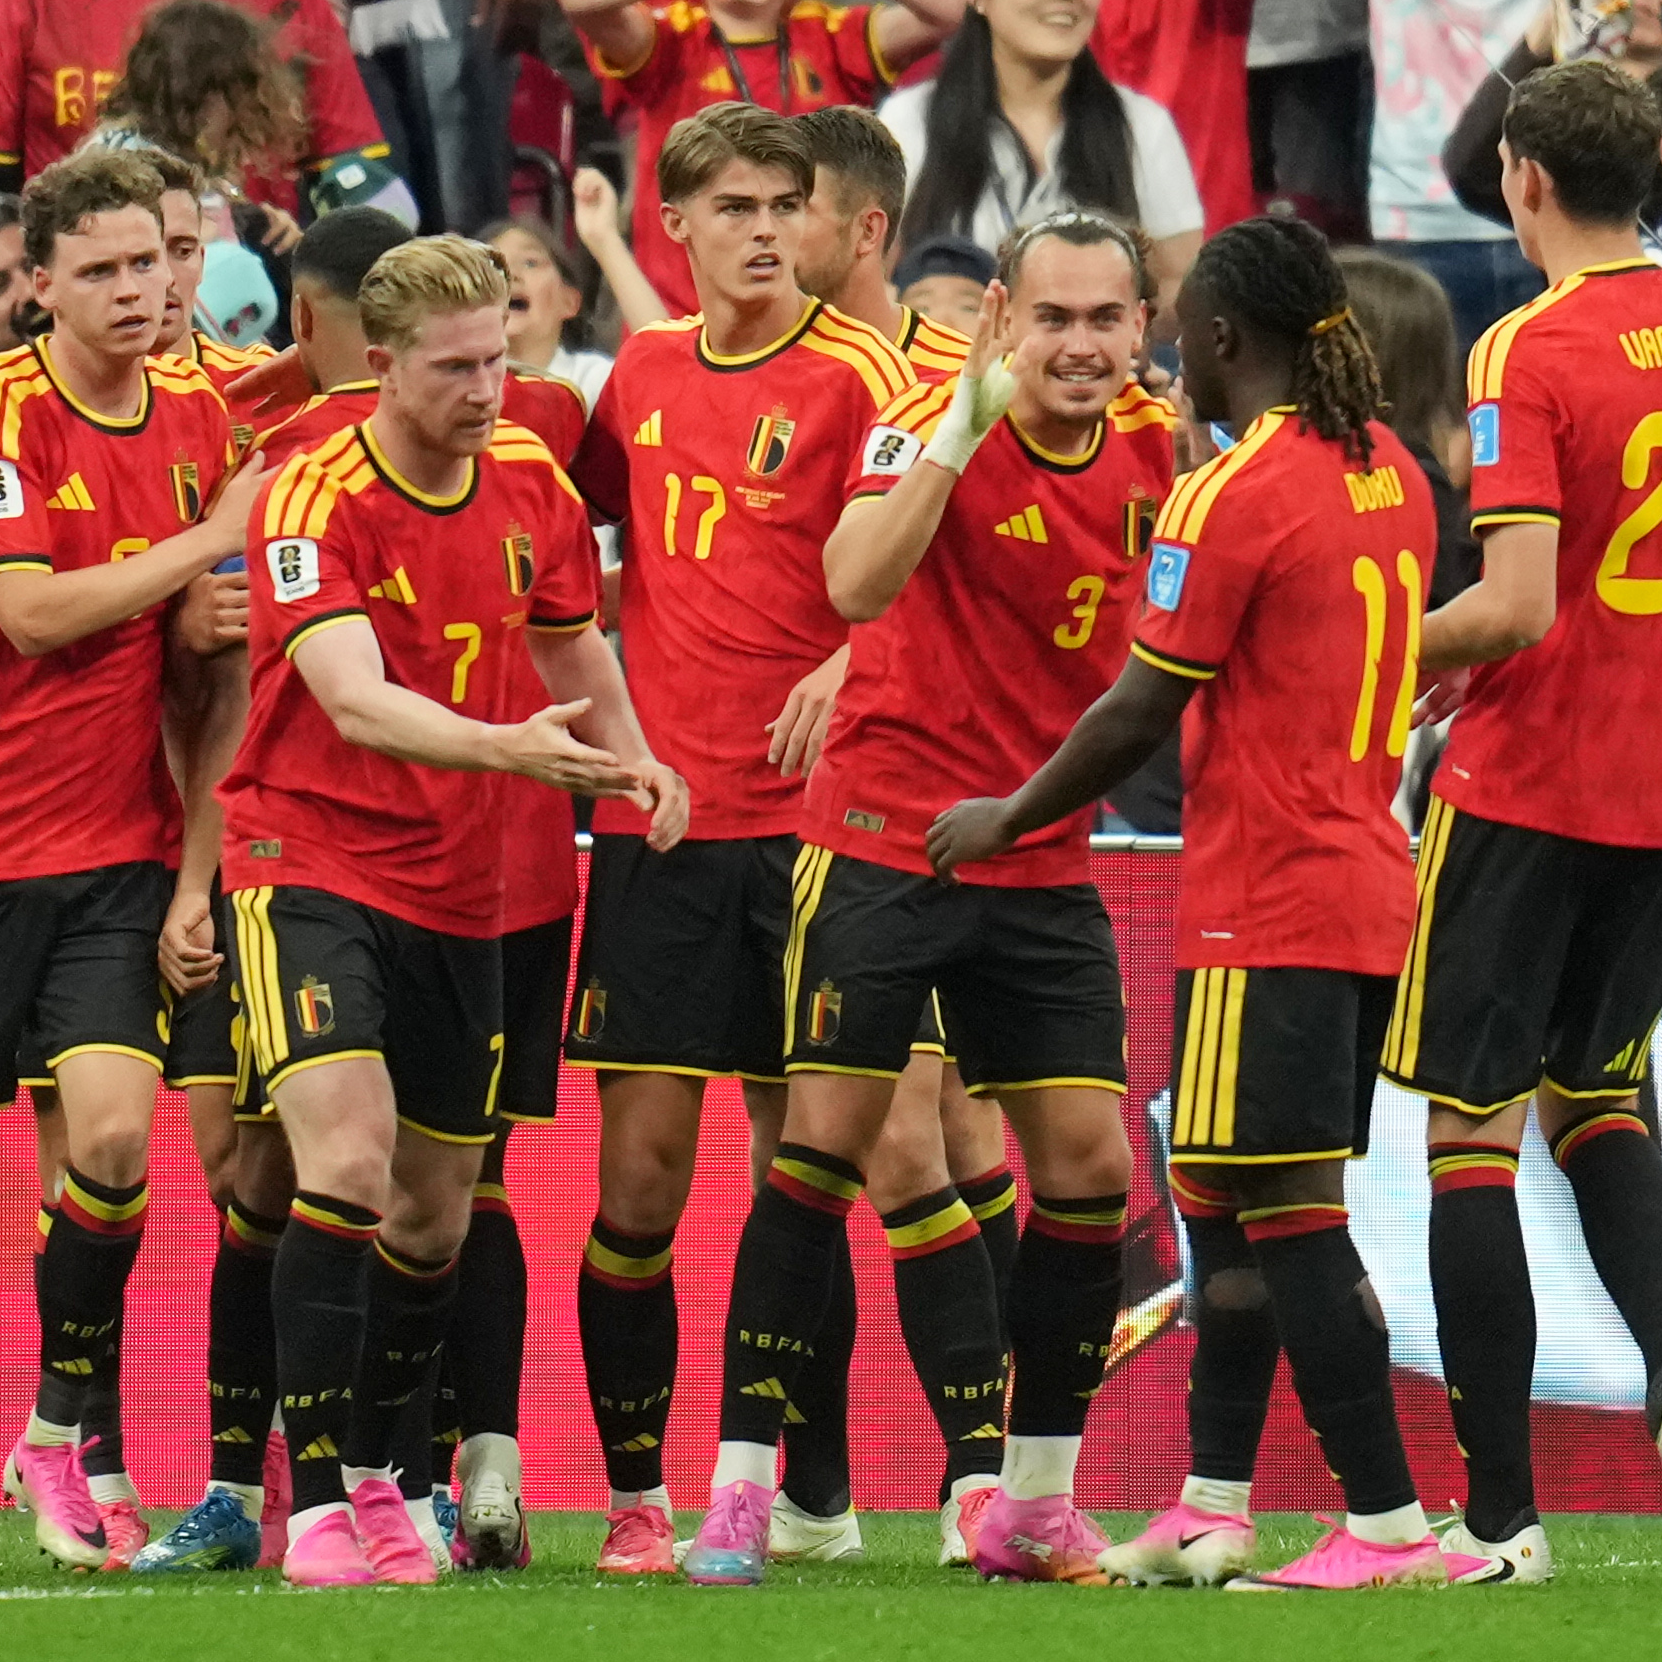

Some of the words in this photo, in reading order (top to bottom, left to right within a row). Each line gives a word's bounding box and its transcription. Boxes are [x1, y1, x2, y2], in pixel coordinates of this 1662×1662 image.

[1343, 465, 1405, 514] DOKU
[664, 472, 727, 560] 17
[1053, 575, 1105, 650] 3
[443, 622, 482, 705] 7
[1349, 549, 1423, 763] 11
[739, 1329, 802, 1353] RBFA
[283, 1387, 354, 1410] RBFA
[599, 1385, 671, 1412] RBFA
[943, 1377, 1005, 1401] RBFA
